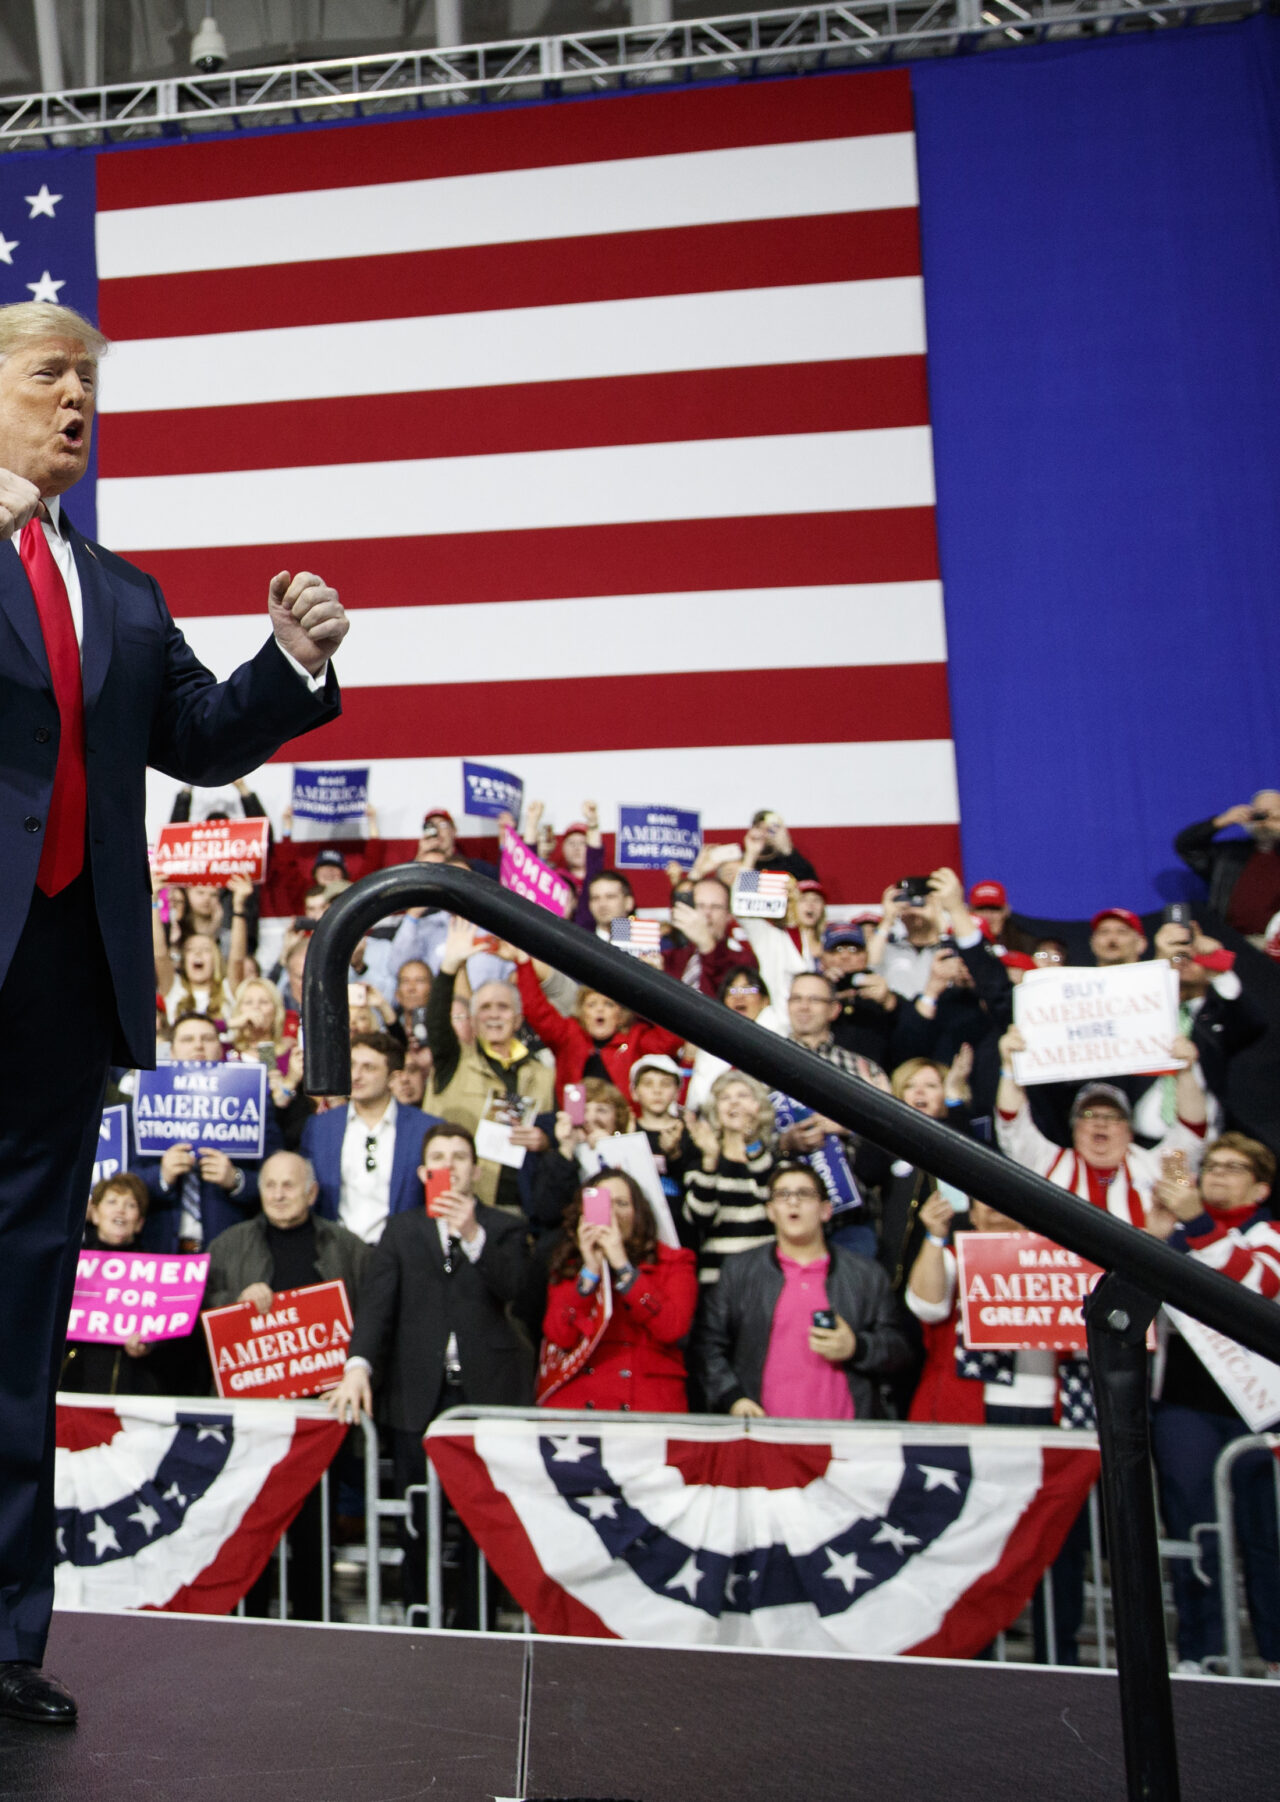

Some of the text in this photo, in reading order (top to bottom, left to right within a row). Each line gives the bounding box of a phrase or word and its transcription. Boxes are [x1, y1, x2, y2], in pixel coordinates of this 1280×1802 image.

[622, 824, 701, 848] AMERICA
[157, 839, 263, 860] AMERICA
[209, 860, 256, 874] AGAIN
[1062, 980, 1106, 999] BUY
[1024, 991, 1162, 1025] AMERICAN
[1067, 1020, 1115, 1041] HIRE
[1026, 1033, 1172, 1067] AMERICAN
[173, 1075, 219, 1091] MAKE
[138, 1094, 260, 1121] AMERICA
[139, 1120, 259, 1142] STRONG AGAIN
[1019, 1249, 1082, 1268] MAKE
[76, 1257, 208, 1284] WOMEN
[105, 1287, 158, 1308] FOR
[67, 1308, 190, 1337] TRUMP
[250, 1307, 300, 1333] MAKE
[979, 1306, 1055, 1327] GREAT
[218, 1319, 352, 1373] AMERICA
[230, 1347, 347, 1392] GREAT AGAIN
